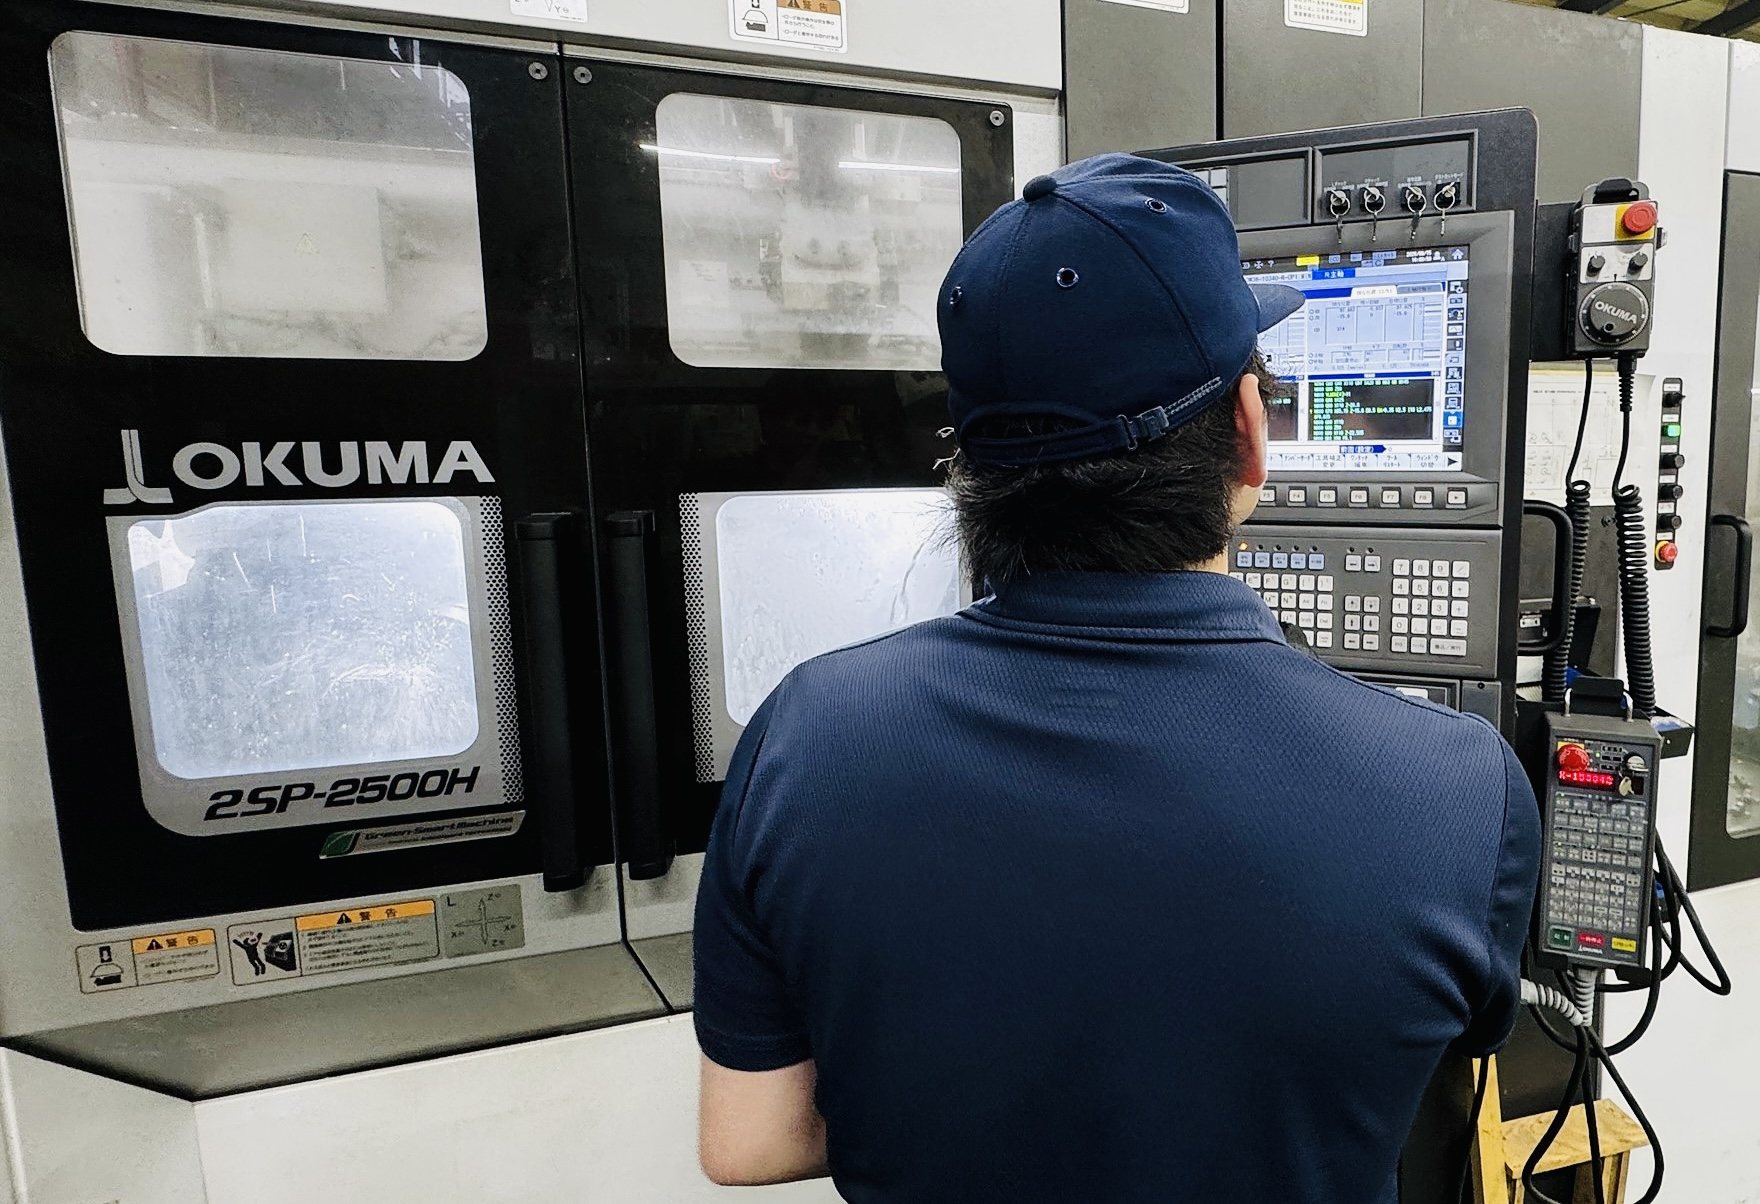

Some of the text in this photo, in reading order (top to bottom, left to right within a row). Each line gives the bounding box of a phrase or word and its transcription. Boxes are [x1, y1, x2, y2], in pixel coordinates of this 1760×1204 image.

[1324, 269, 1345, 278] R主軸
[1595, 301, 1638, 324] OKUMA
[172, 440, 496, 489] OKUMA
[203, 766, 481, 821] 2SP-2500H
[359, 907, 398, 922] 警告
[165, 935, 199, 948] 警告
